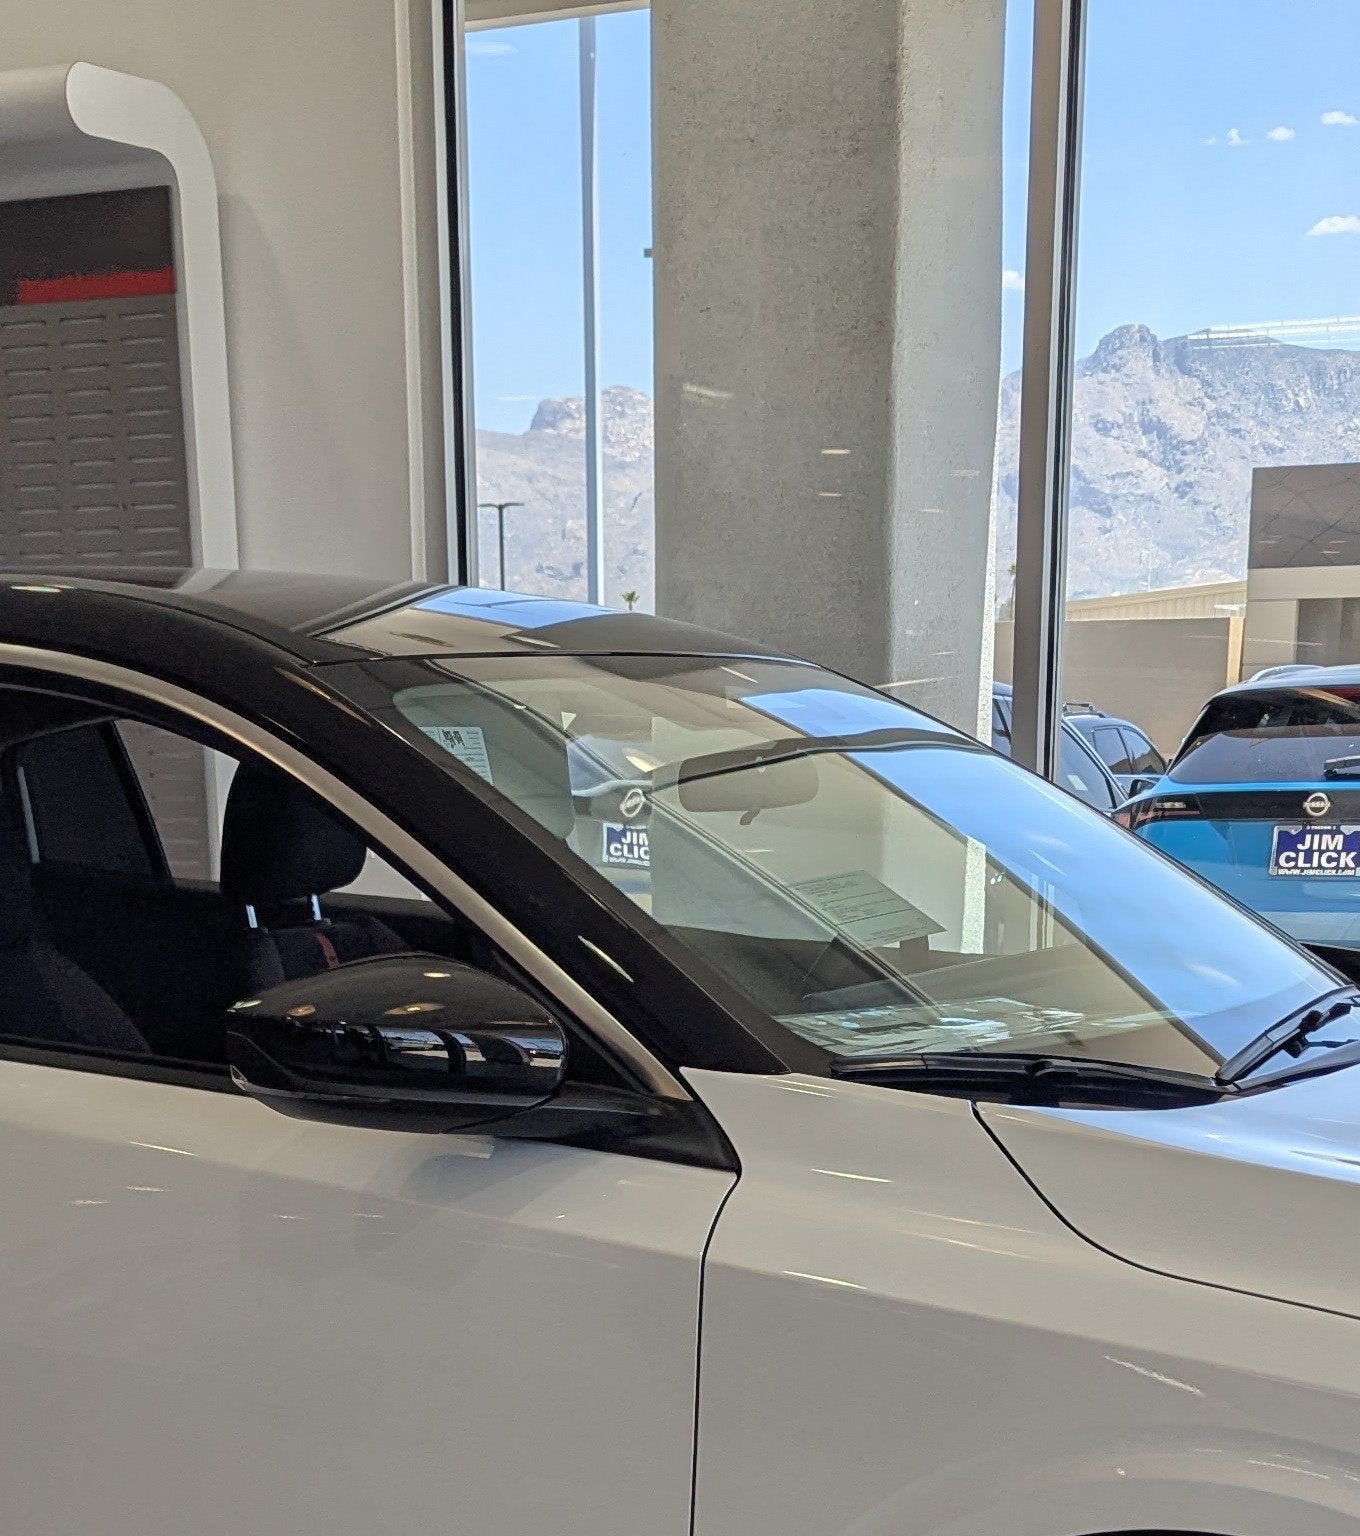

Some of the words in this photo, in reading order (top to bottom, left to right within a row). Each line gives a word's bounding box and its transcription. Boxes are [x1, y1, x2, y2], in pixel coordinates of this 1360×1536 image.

[1296, 833, 1344, 851] JIM
[609, 843, 650, 860] CLIC
[1278, 851, 1357, 868] CLICK
